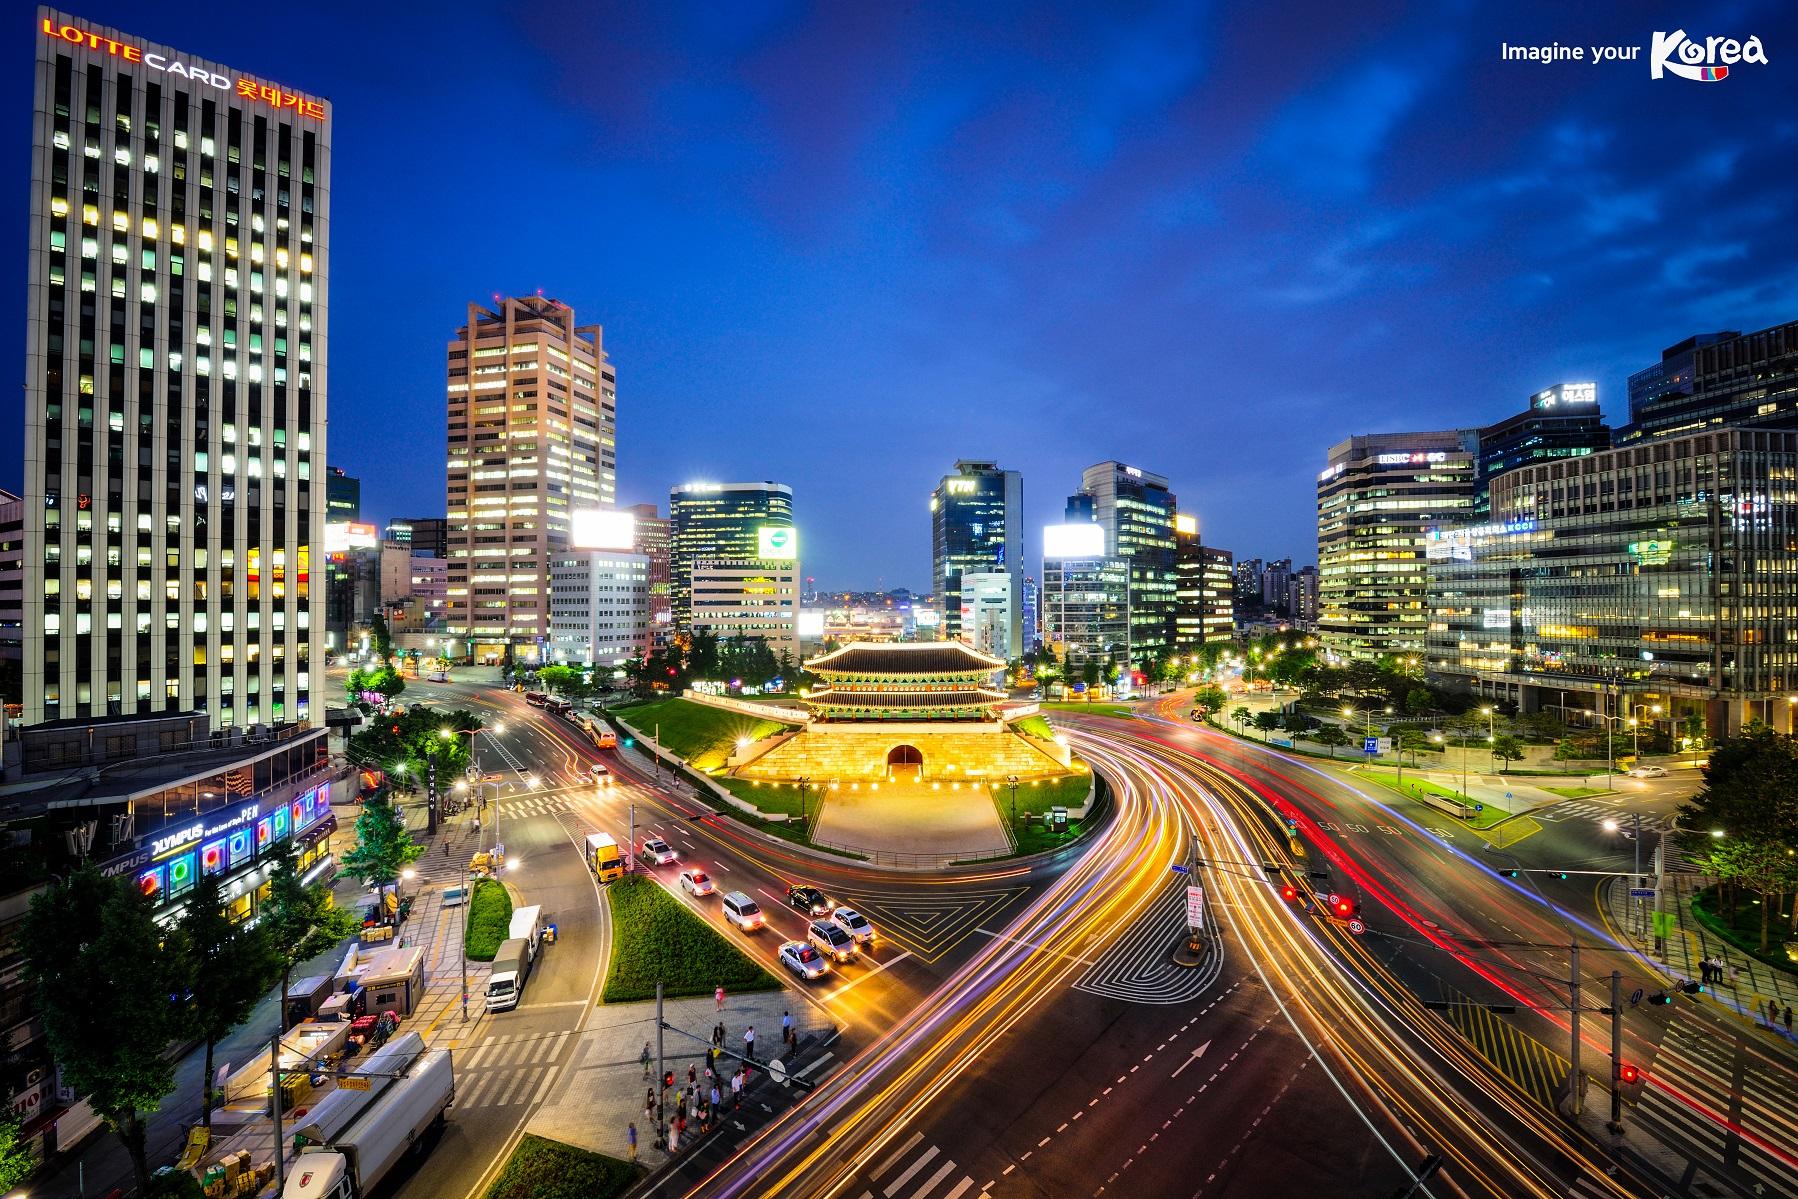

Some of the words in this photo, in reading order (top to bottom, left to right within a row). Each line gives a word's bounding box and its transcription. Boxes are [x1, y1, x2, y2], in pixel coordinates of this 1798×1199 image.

[236, 77, 326, 121] 롯데카드
[948, 479, 976, 495] YTN
[1507, 521, 1533, 532] KCCI
[241, 804, 259, 823] PEN
[100, 852, 150, 878] YMPUS
